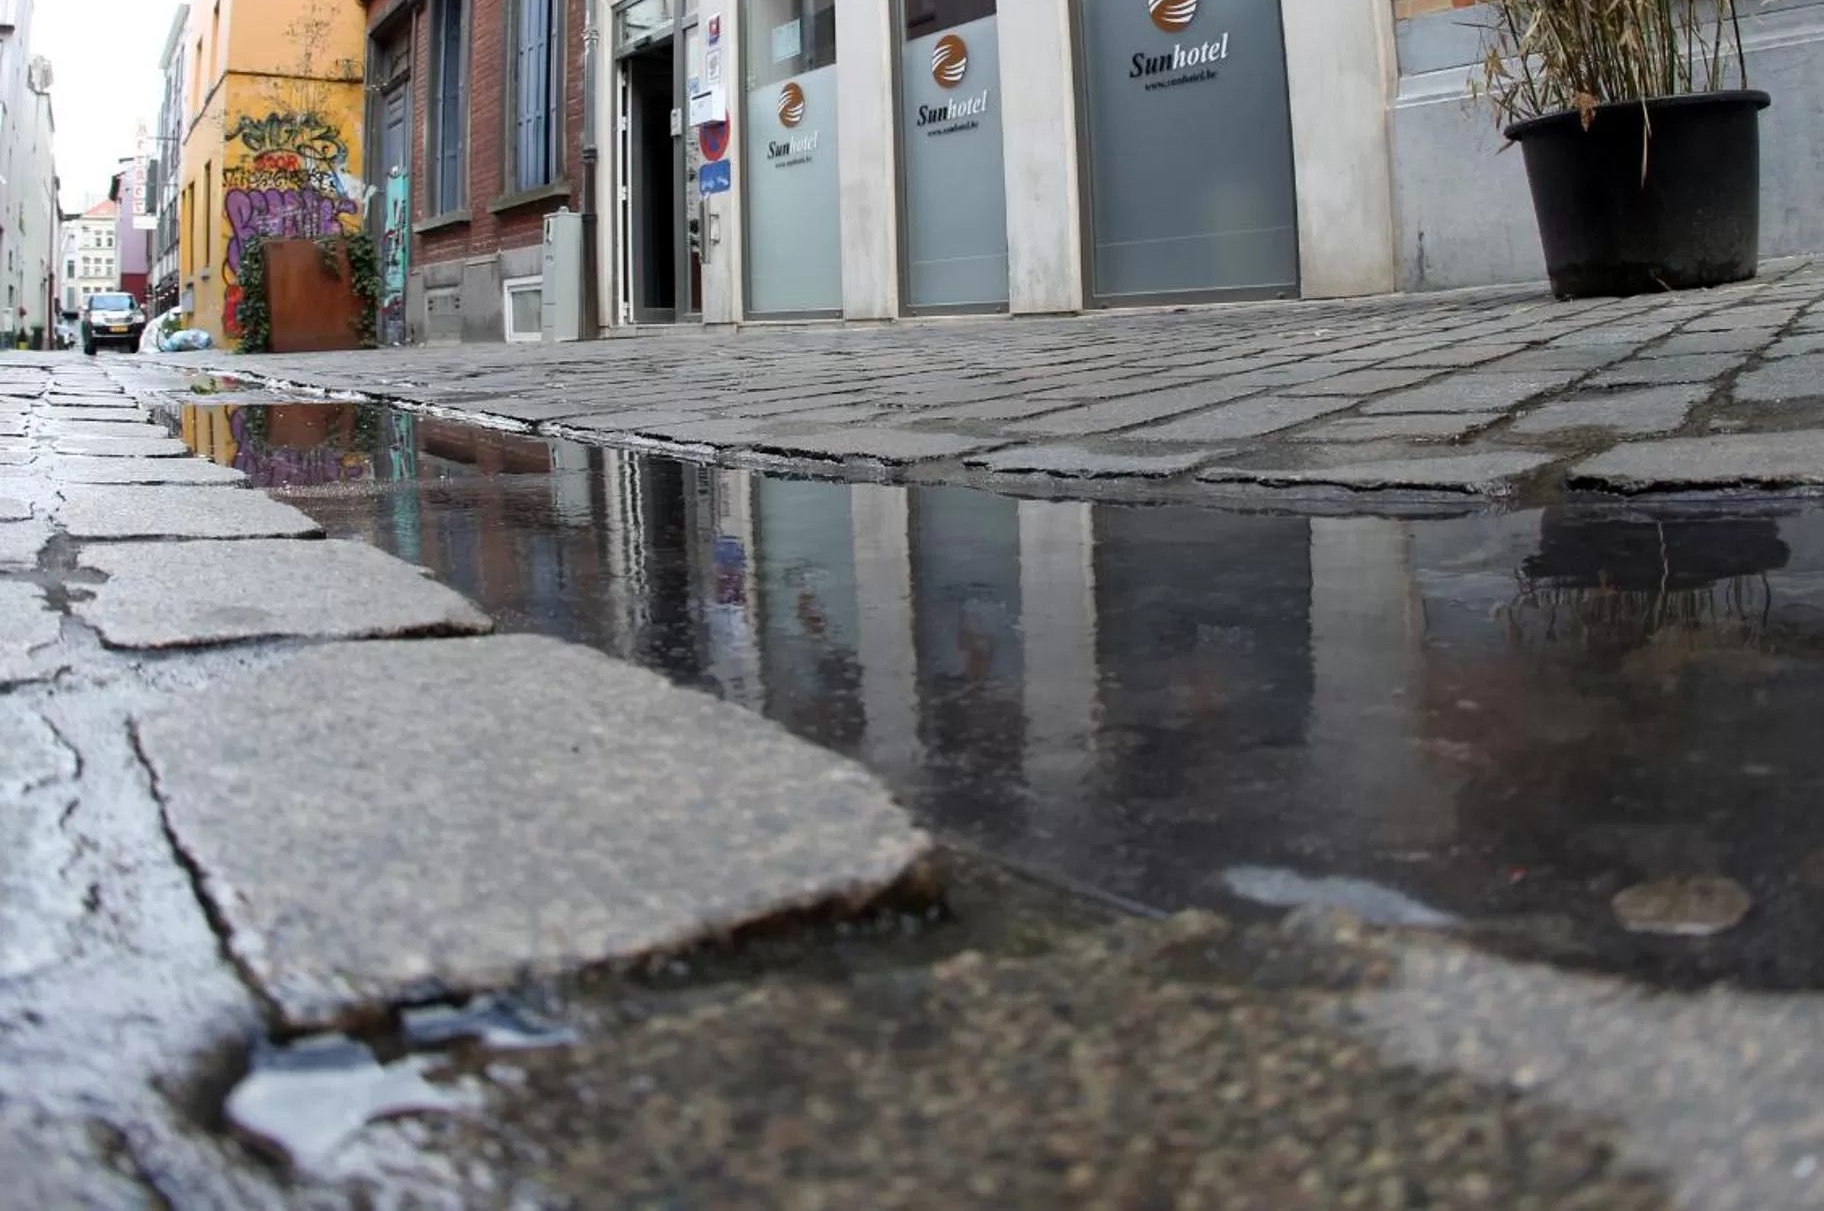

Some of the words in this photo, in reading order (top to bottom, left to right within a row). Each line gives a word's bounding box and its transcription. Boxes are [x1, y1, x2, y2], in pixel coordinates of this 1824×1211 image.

[1129, 32, 1229, 78] Sunhotel
[917, 89, 988, 127] Sunhotel
[766, 130, 818, 161] Sunhotel
